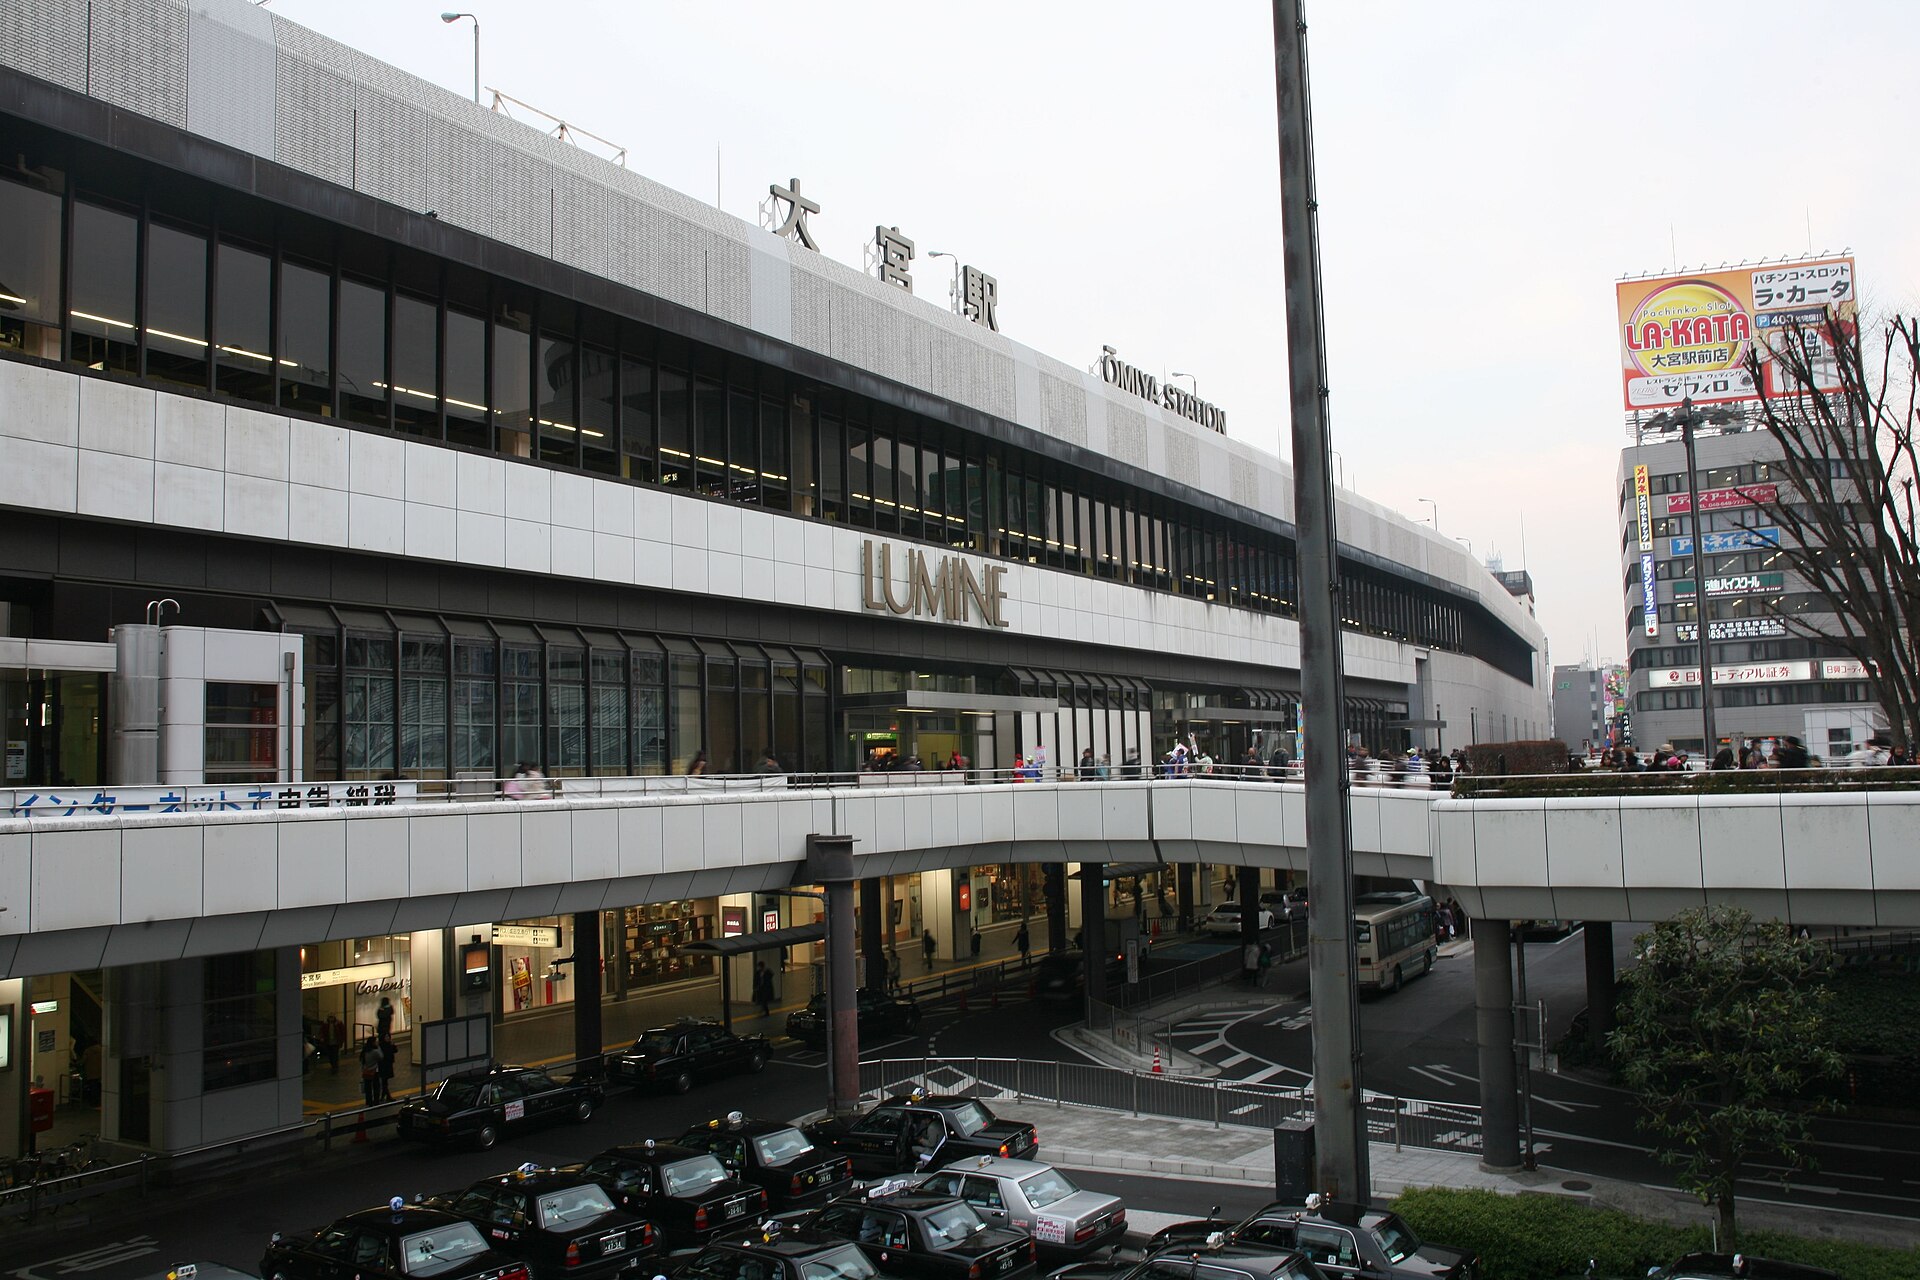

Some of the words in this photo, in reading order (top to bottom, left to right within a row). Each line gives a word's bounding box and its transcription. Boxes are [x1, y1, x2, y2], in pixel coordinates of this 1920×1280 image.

[770, 177, 999, 333] 大宮駅
[1754, 265, 1849, 285] パチンコ・スロット
[1754, 279, 1850, 307] ラ・カータ
[1651, 348, 1728, 368] 大宮駅前店
[1661, 379, 1729, 397] ゼフィロ
[1163, 383, 1228, 437] STATION
[1637, 466, 1647, 493] メガネ
[1639, 494, 1650, 542] メガネドラッグ
[1676, 532, 1773, 552] アトネイチャー
[863, 539, 1010, 628] LUMINE
[1642, 555, 1655, 611] アパマンショップ
[1685, 666, 1791, 682] 日コーディアル証券
[302, 973, 322, 982] 大宮駅
[356, 978, 405, 996] Coolens
